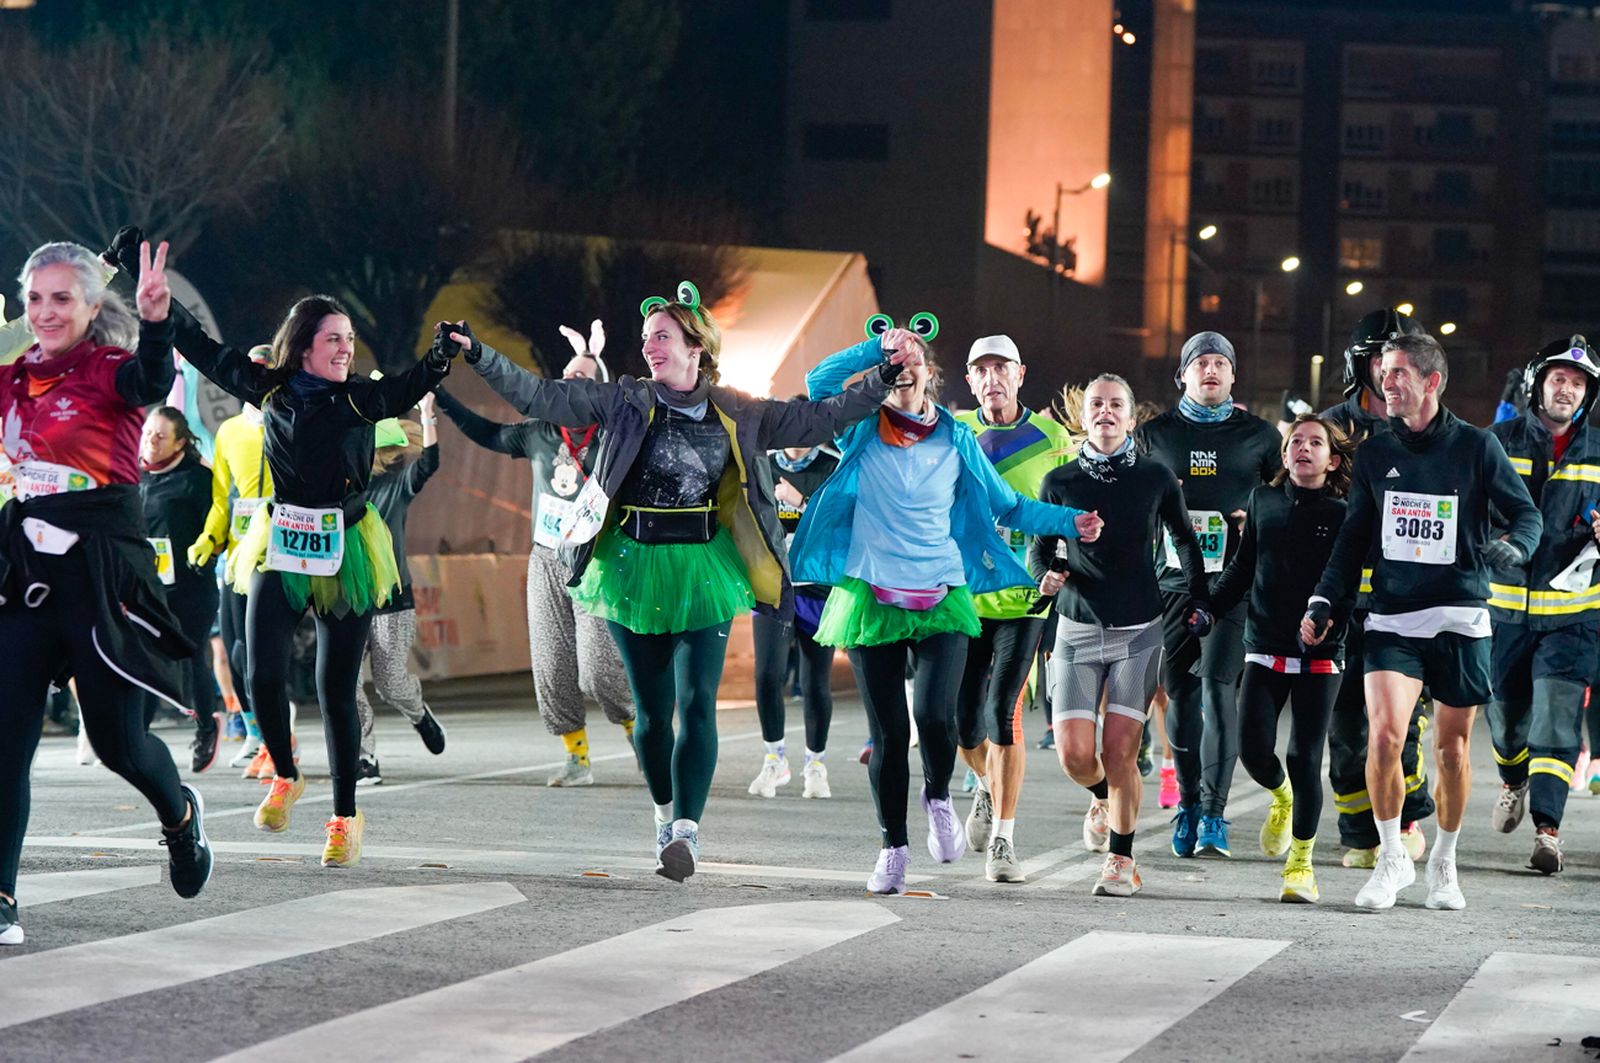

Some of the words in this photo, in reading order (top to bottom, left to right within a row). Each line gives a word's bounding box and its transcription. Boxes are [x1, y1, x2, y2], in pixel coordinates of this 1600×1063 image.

[1190, 467, 1217, 476] BOX
[48, 474, 59, 483] DE
[1400, 500, 1422, 508] NOCHE
[1423, 502, 1431, 510] DE
[778, 511, 800, 519] BOX
[1392, 507, 1406, 516] SAN
[278, 518, 290, 527] SAN
[1395, 516, 1445, 541] 3083
[281, 528, 331, 553] 12781
